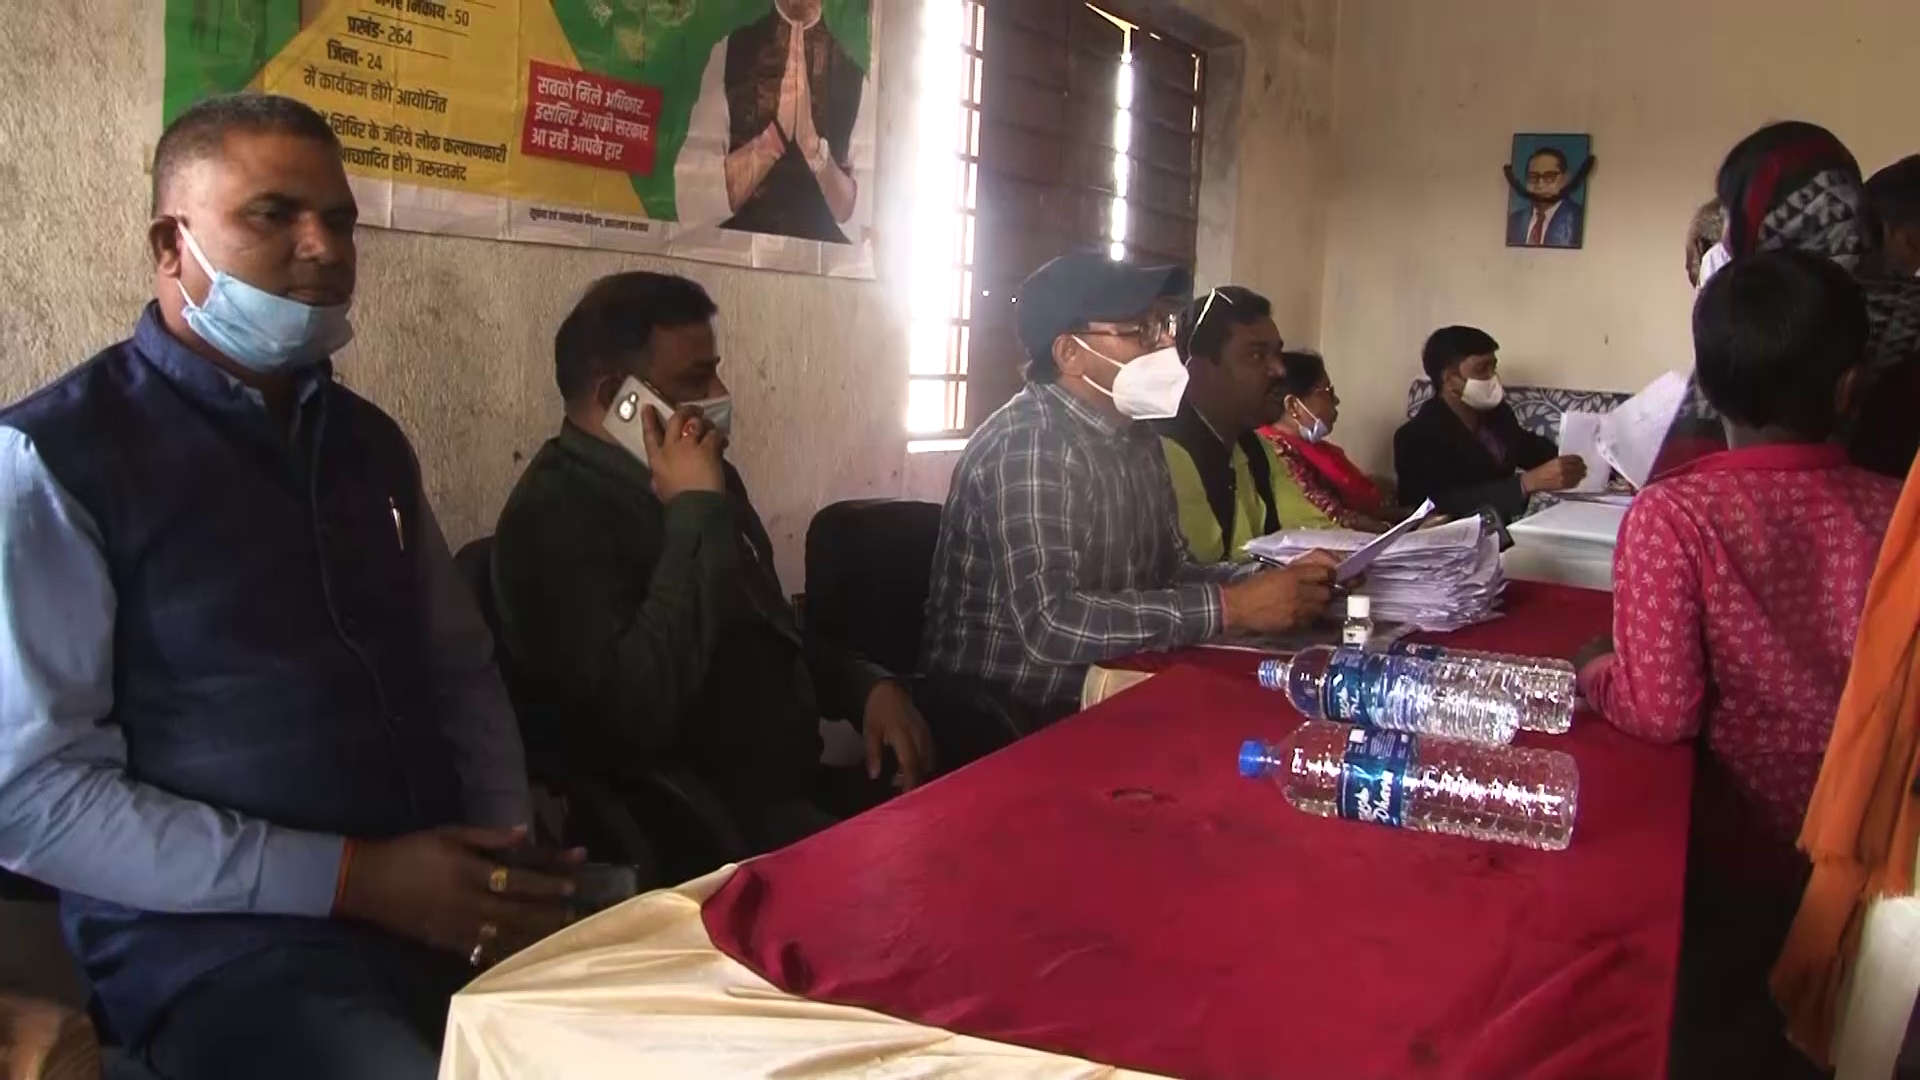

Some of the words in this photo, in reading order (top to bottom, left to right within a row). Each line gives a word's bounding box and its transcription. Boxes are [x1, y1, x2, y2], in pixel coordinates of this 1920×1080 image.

[454, 8, 470, 26] 50
[387, 26, 413, 46] 264
[367, 53, 383, 70] 24
[304, 65, 318, 88] में
[319, 70, 368, 97] कार्यक्रम
[370, 80, 393, 103] होंगे
[396, 88, 448, 114] आयोजित
[536, 76, 574, 99] सबको
[576, 80, 603, 106] मिले
[534, 101, 579, 127] इसलिए
[579, 111, 613, 133] आपकी
[615, 118, 649, 141] सरकार
[331, 113, 366, 139] शिविर
[368, 119, 380, 140] के
[382, 124, 413, 147] जरिये
[415, 129, 441, 151] लोक
[443, 138, 508, 163] कल्याणकारी
[531, 127, 546, 147] आ
[549, 129, 569, 150] रही
[571, 134, 604, 155] आपके
[392, 151, 413, 174] होंगे
